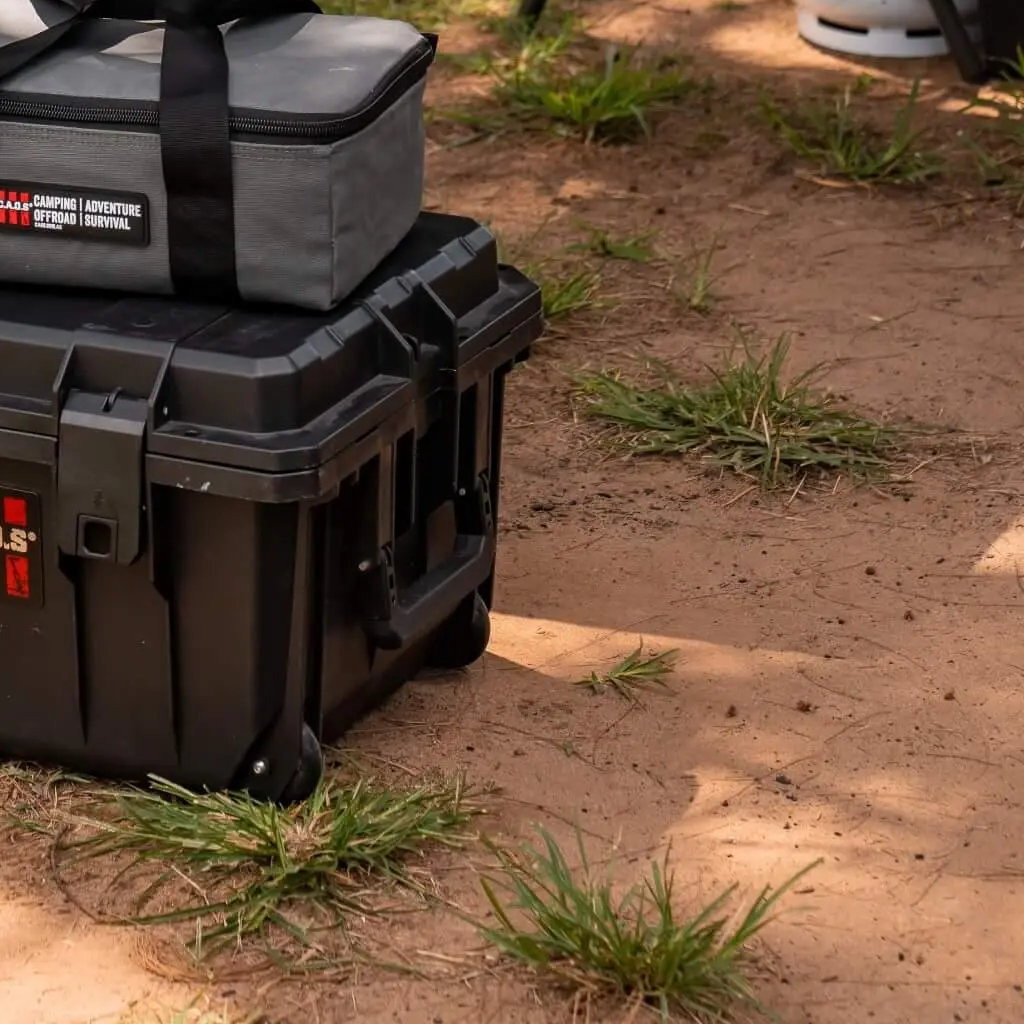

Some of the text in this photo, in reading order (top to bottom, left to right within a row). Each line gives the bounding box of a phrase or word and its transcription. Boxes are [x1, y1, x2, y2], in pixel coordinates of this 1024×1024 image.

[33, 194, 142, 218] CAMPING ADVENTURE
[33, 209, 131, 231] OFFROAD SURVIVAL
